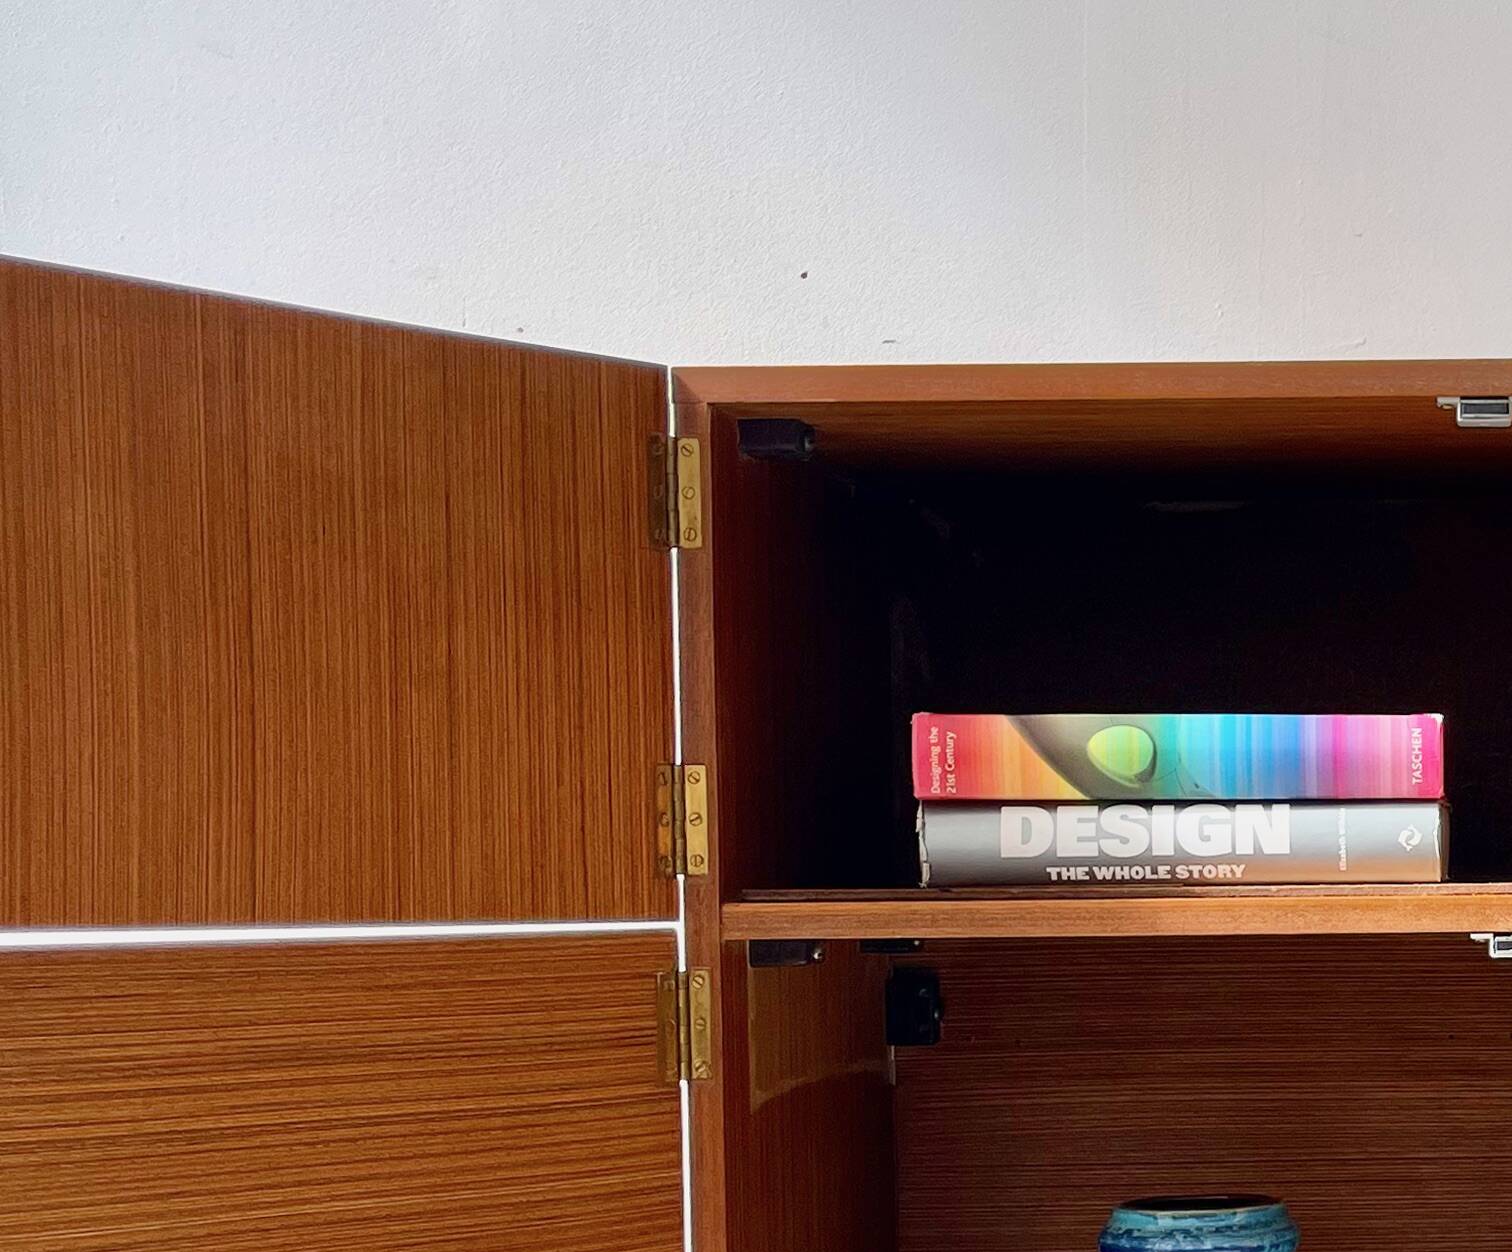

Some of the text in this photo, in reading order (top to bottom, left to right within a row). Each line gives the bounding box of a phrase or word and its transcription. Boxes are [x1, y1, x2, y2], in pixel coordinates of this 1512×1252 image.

[928, 726, 942, 794] Designing the
[944, 731, 957, 794] 21st Century
[1410, 727, 1423, 785] TASCHEN
[1000, 804, 1291, 859] DESIGN
[1046, 864, 1246, 881] THE WHOLE STORY
